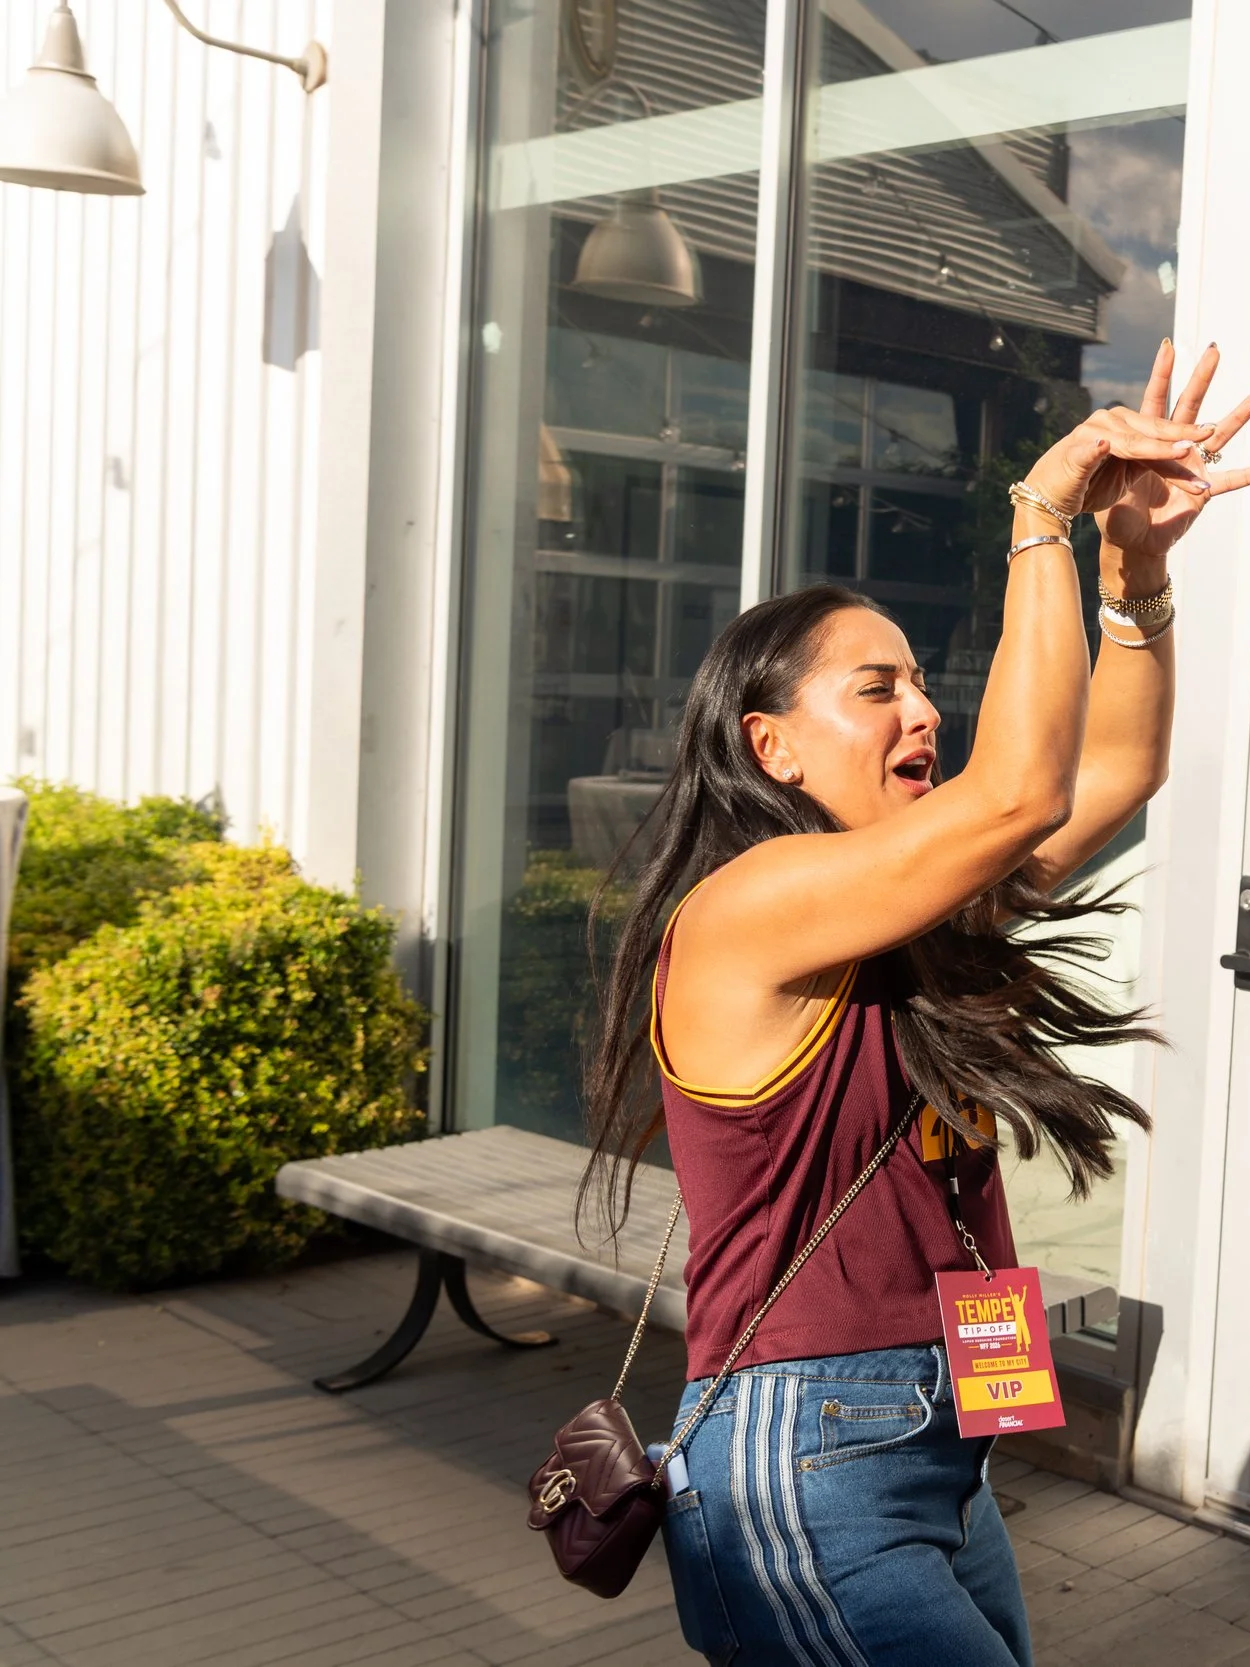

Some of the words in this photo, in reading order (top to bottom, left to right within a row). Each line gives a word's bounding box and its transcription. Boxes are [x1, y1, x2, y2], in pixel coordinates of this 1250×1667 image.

[955, 1297, 1015, 1324] TEMPE
[963, 1324, 1012, 1335] TIP-OFF
[975, 1360, 998, 1369] WELCOME
[999, 1360, 1006, 1368] TO
[1006, 1359, 1015, 1367] MY
[1015, 1358, 1027, 1366] CITY
[986, 1380, 1023, 1400] VIP
